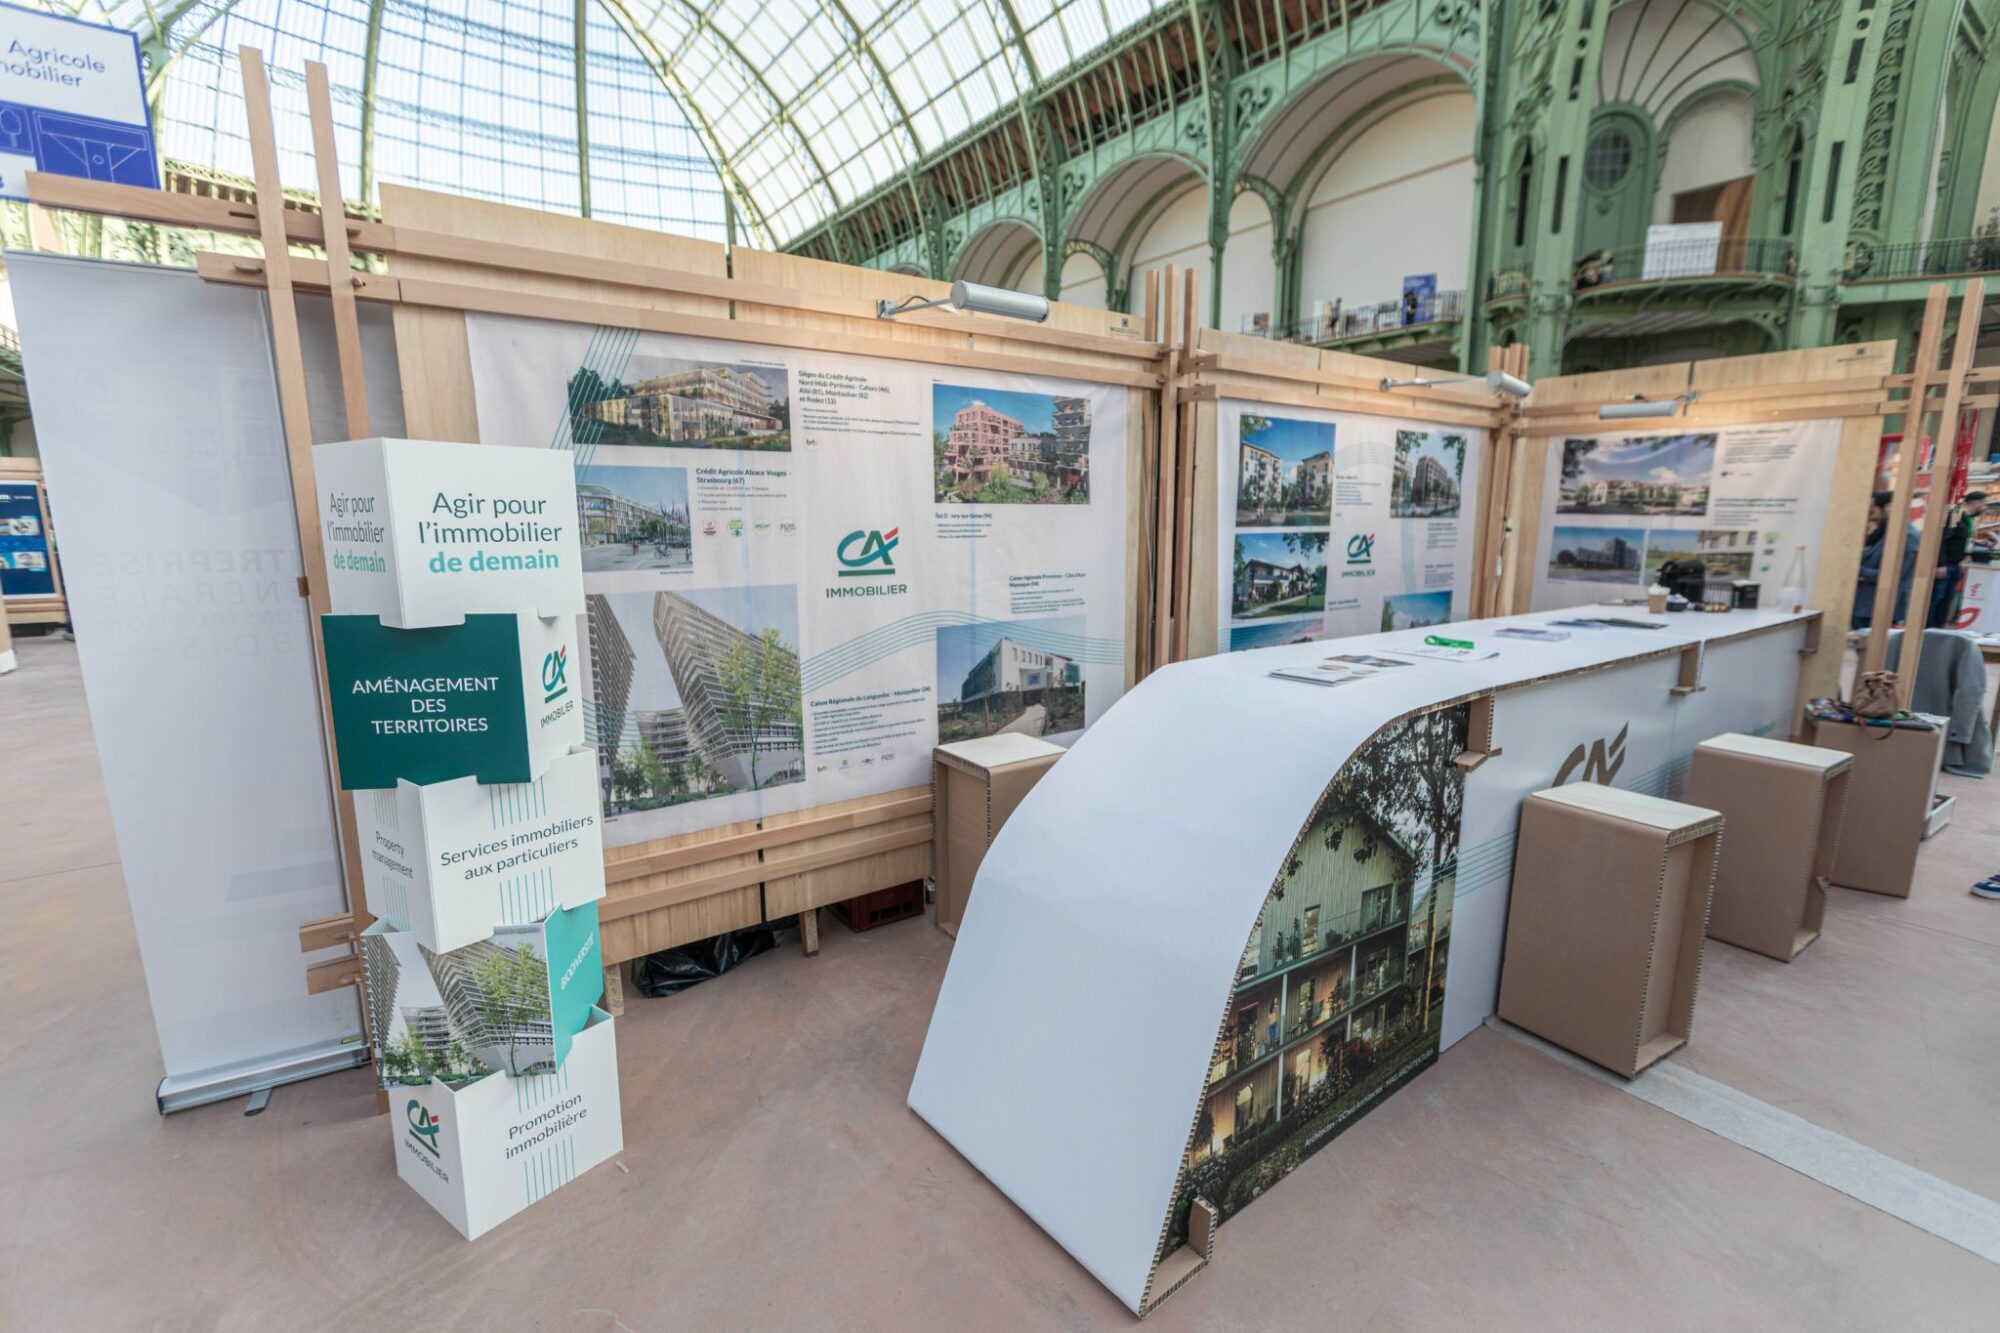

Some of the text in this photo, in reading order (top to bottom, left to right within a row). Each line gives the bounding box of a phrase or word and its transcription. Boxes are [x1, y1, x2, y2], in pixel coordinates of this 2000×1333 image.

[9, 40, 105, 73] Agricole
[330, 492, 375, 517] Agir pour
[432, 492, 547, 518] Agir pour
[327, 520, 385, 544] l'immobilier
[418, 521, 563, 544] l’immobilier
[333, 549, 386, 573] de demain
[429, 549, 560, 573] de demain
[1342, 569, 1376, 578] IMMOBILIER
[826, 584, 907, 598] IMMOBILIER
[352, 676, 499, 694] AMÉNAGEMENT
[411, 699, 446, 713] DES
[540, 700, 574, 729] IMMOBILIER
[371, 717, 488, 734] TERRITOIRES
[376, 831, 404, 858] Property
[440, 815, 594, 866] Services immobiliers
[372, 850, 414, 880] management
[464, 838, 578, 880] aux particuliers
[508, 1093, 582, 1140] Promotion
[506, 1108, 587, 1160] immobilière
[404, 1138, 450, 1184] IMMOBILIER
